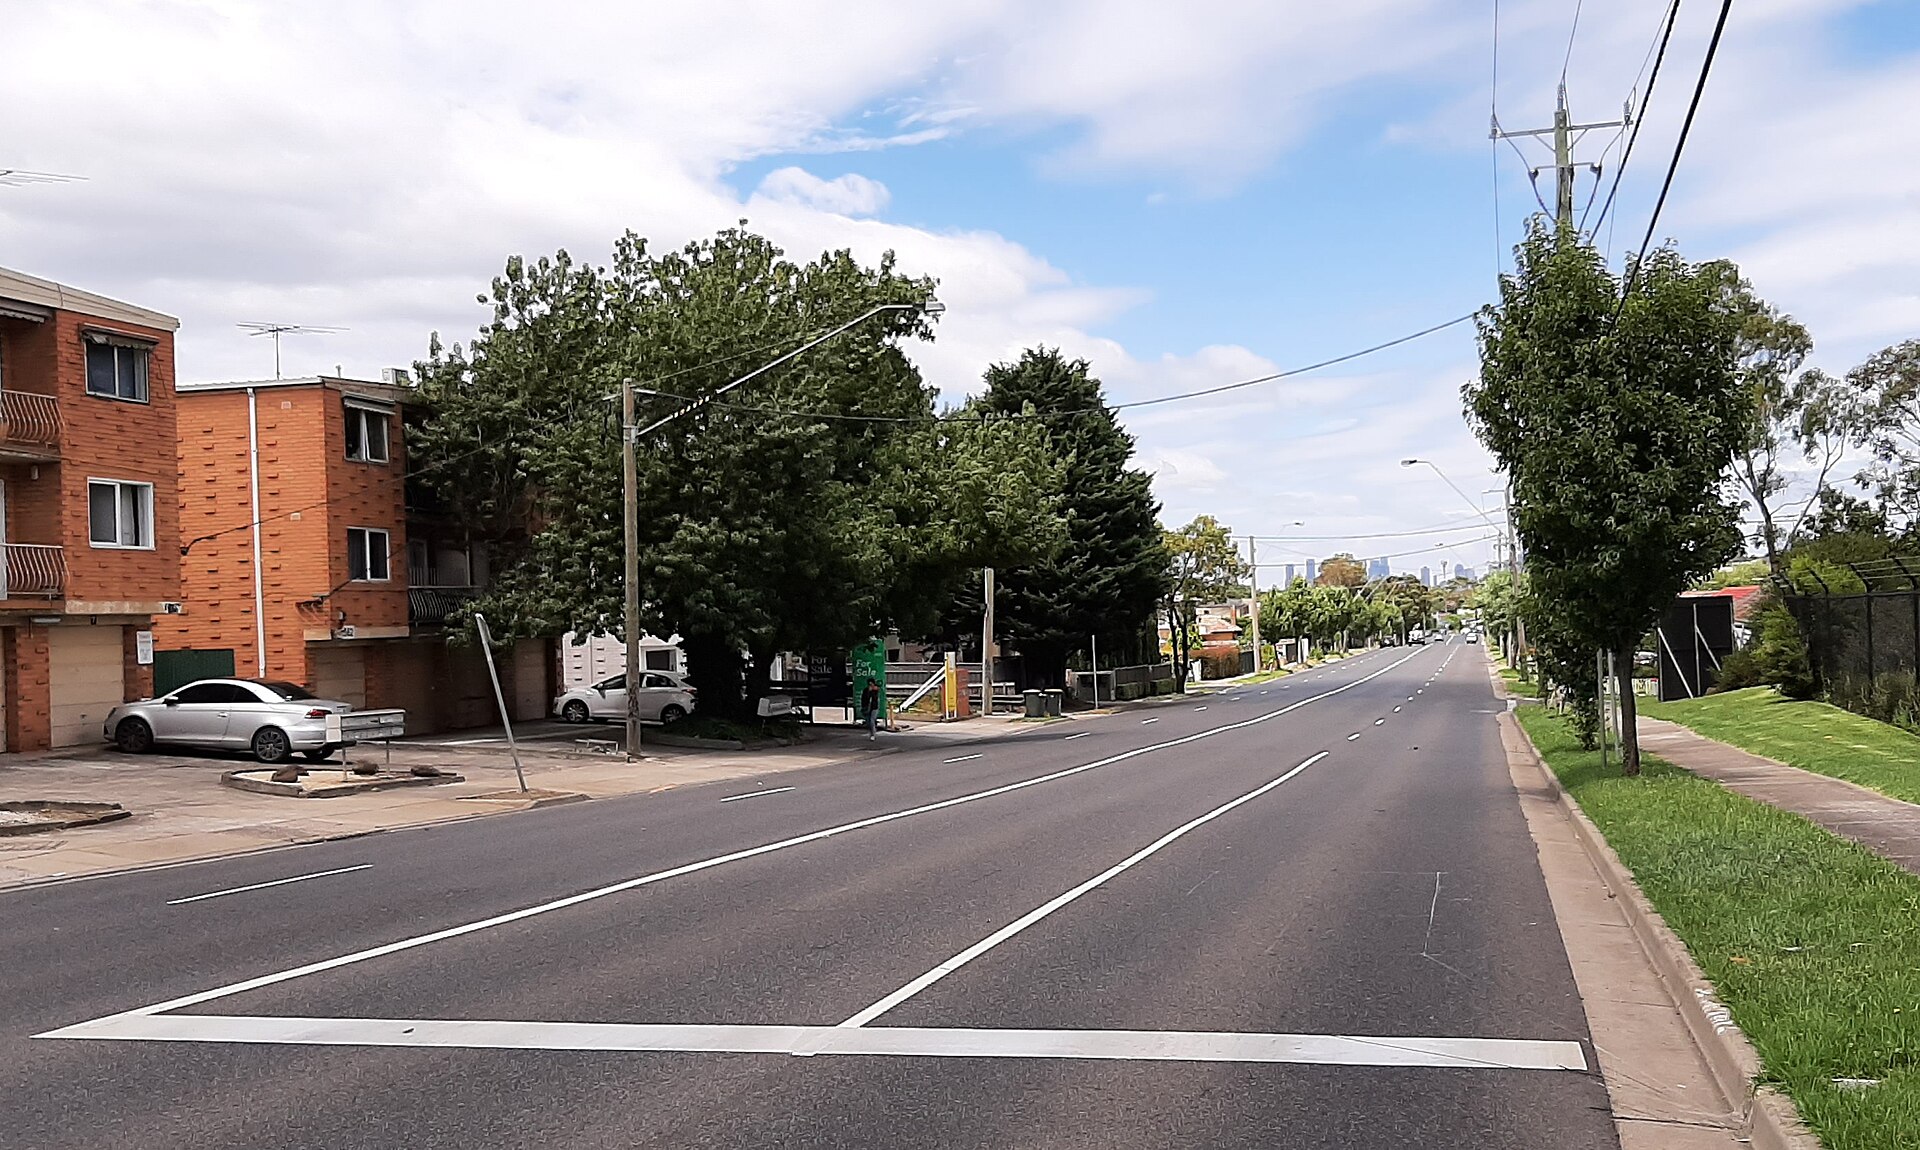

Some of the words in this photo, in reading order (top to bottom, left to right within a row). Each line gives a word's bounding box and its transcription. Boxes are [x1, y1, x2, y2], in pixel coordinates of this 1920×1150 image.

[811, 656, 828, 664] For
[856, 659, 871, 668] For
[811, 664, 833, 674] Sale
[856, 667, 877, 677] Sale
